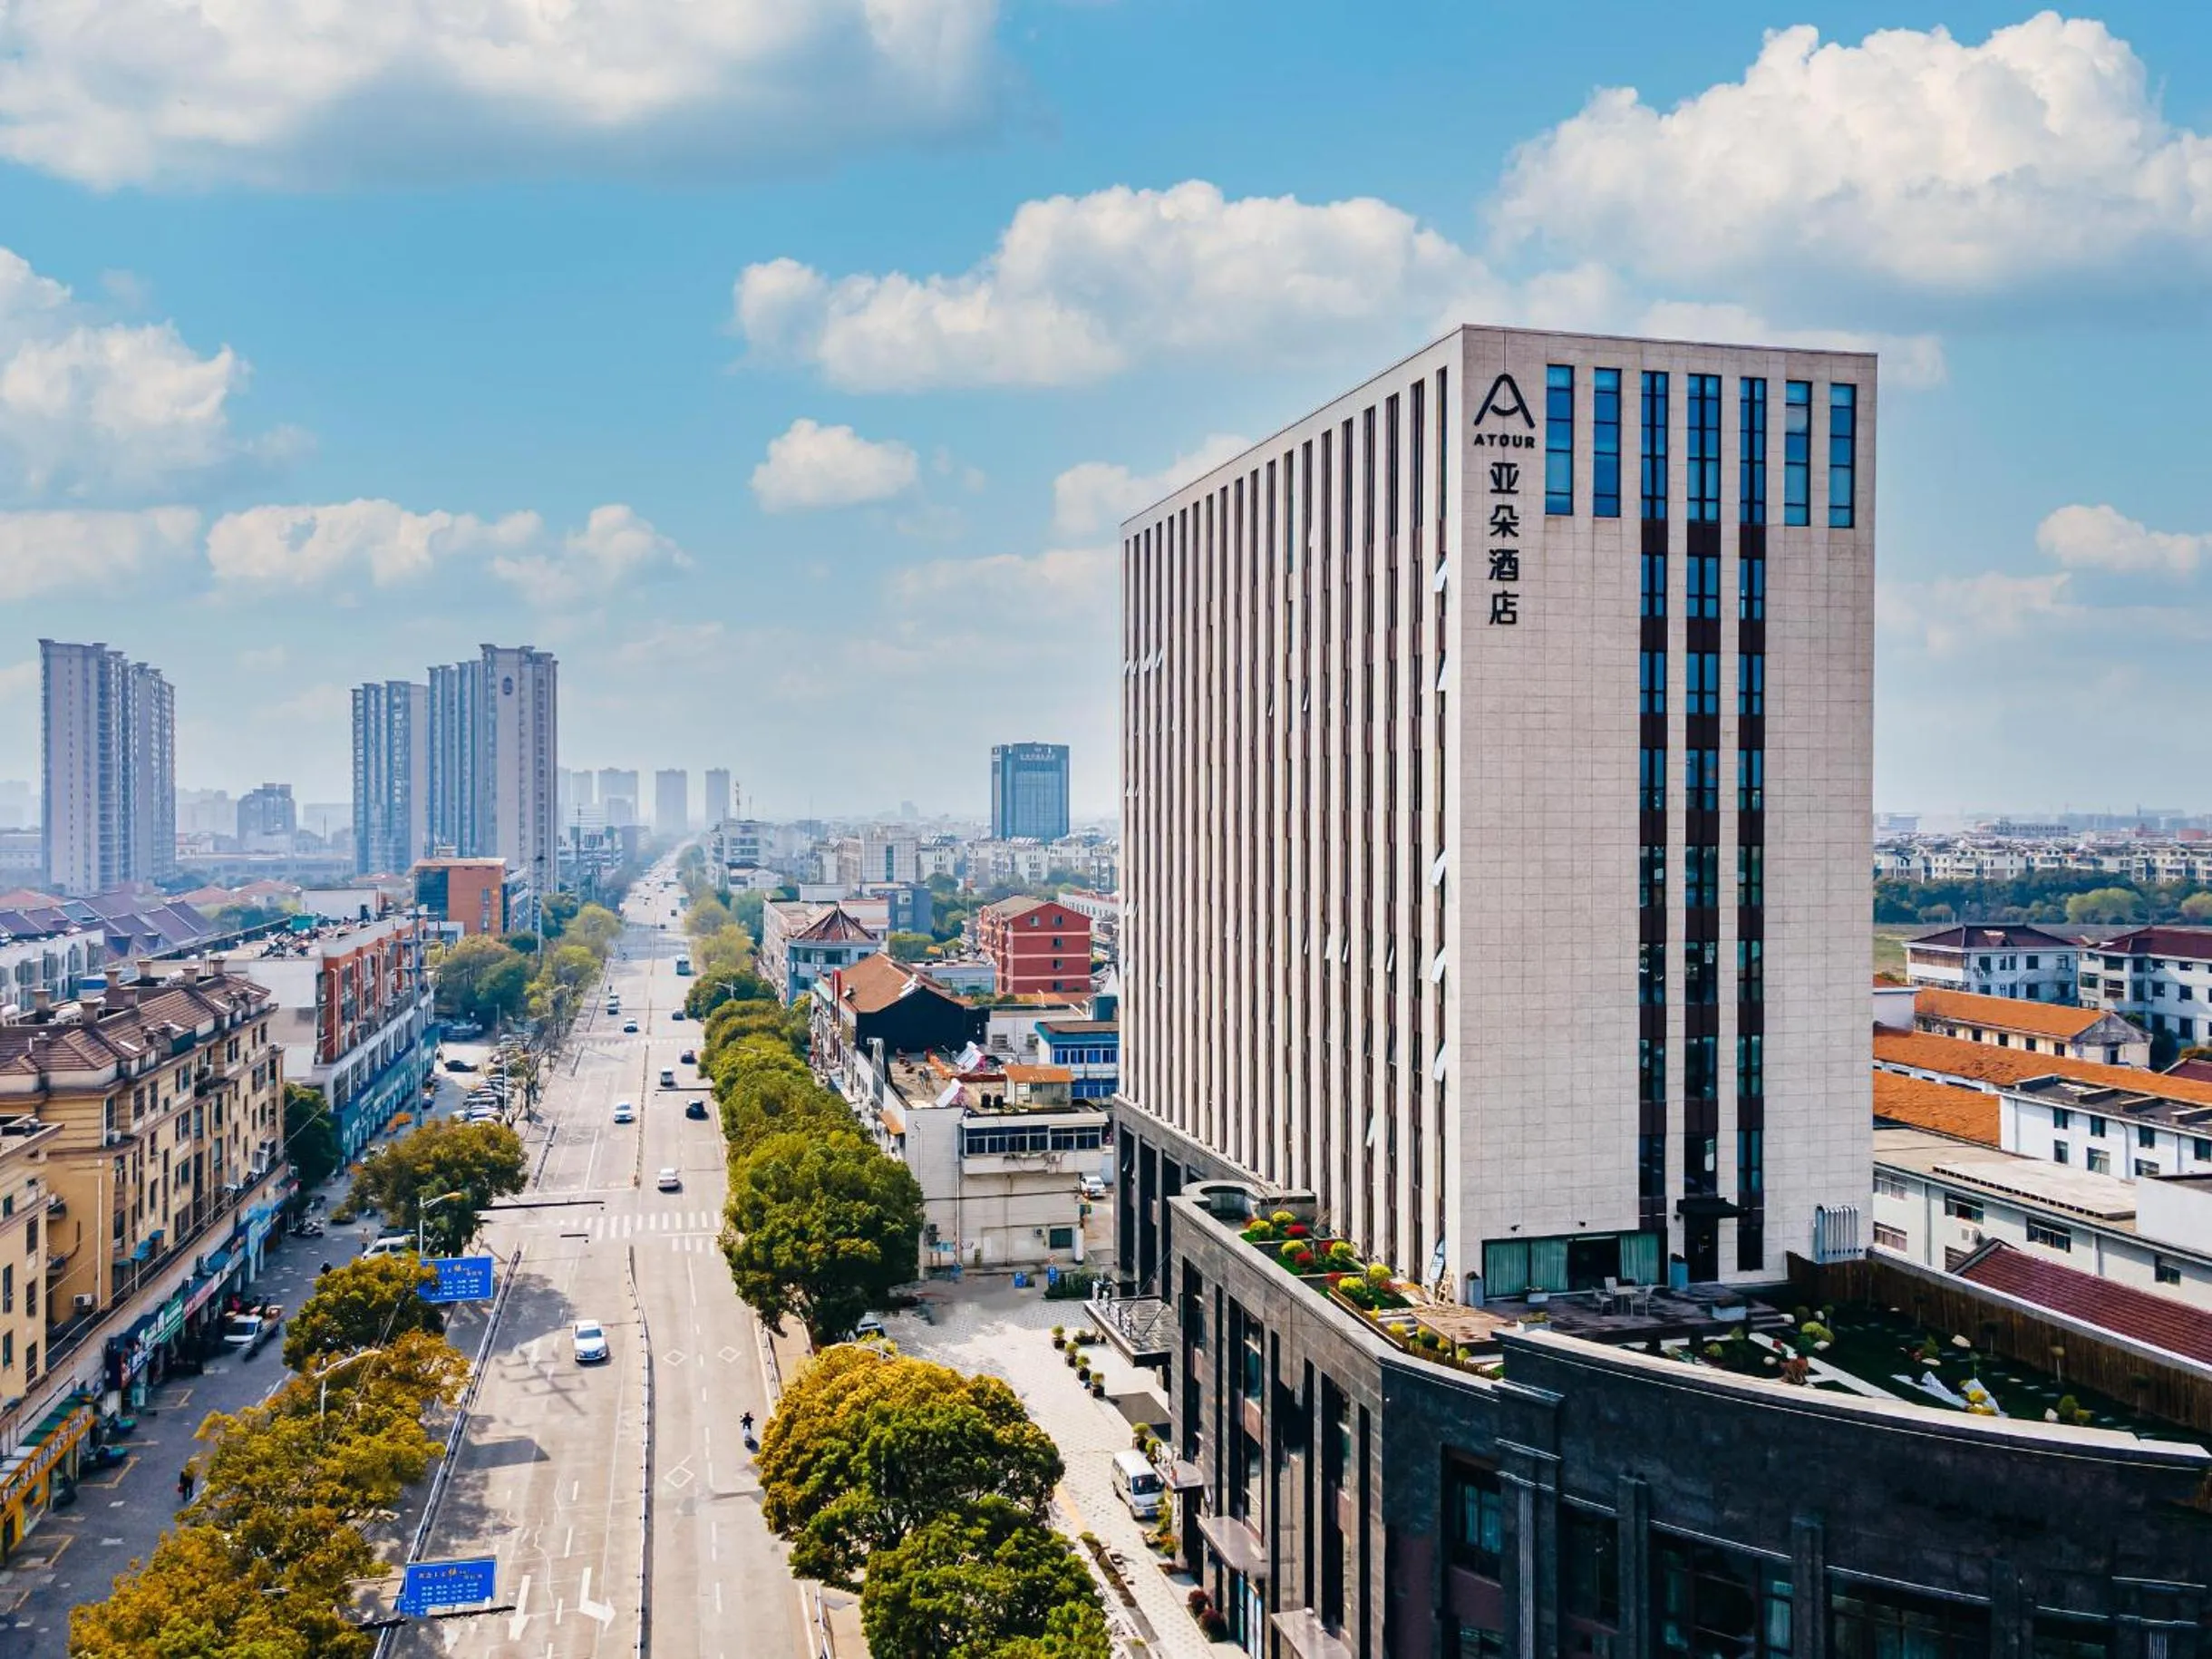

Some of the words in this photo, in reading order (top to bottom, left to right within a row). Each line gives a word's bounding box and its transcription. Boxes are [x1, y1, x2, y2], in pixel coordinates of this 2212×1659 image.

[1473, 433, 1536, 449] ATOUR
[1488, 461, 1520, 626] 亚朵酒店
